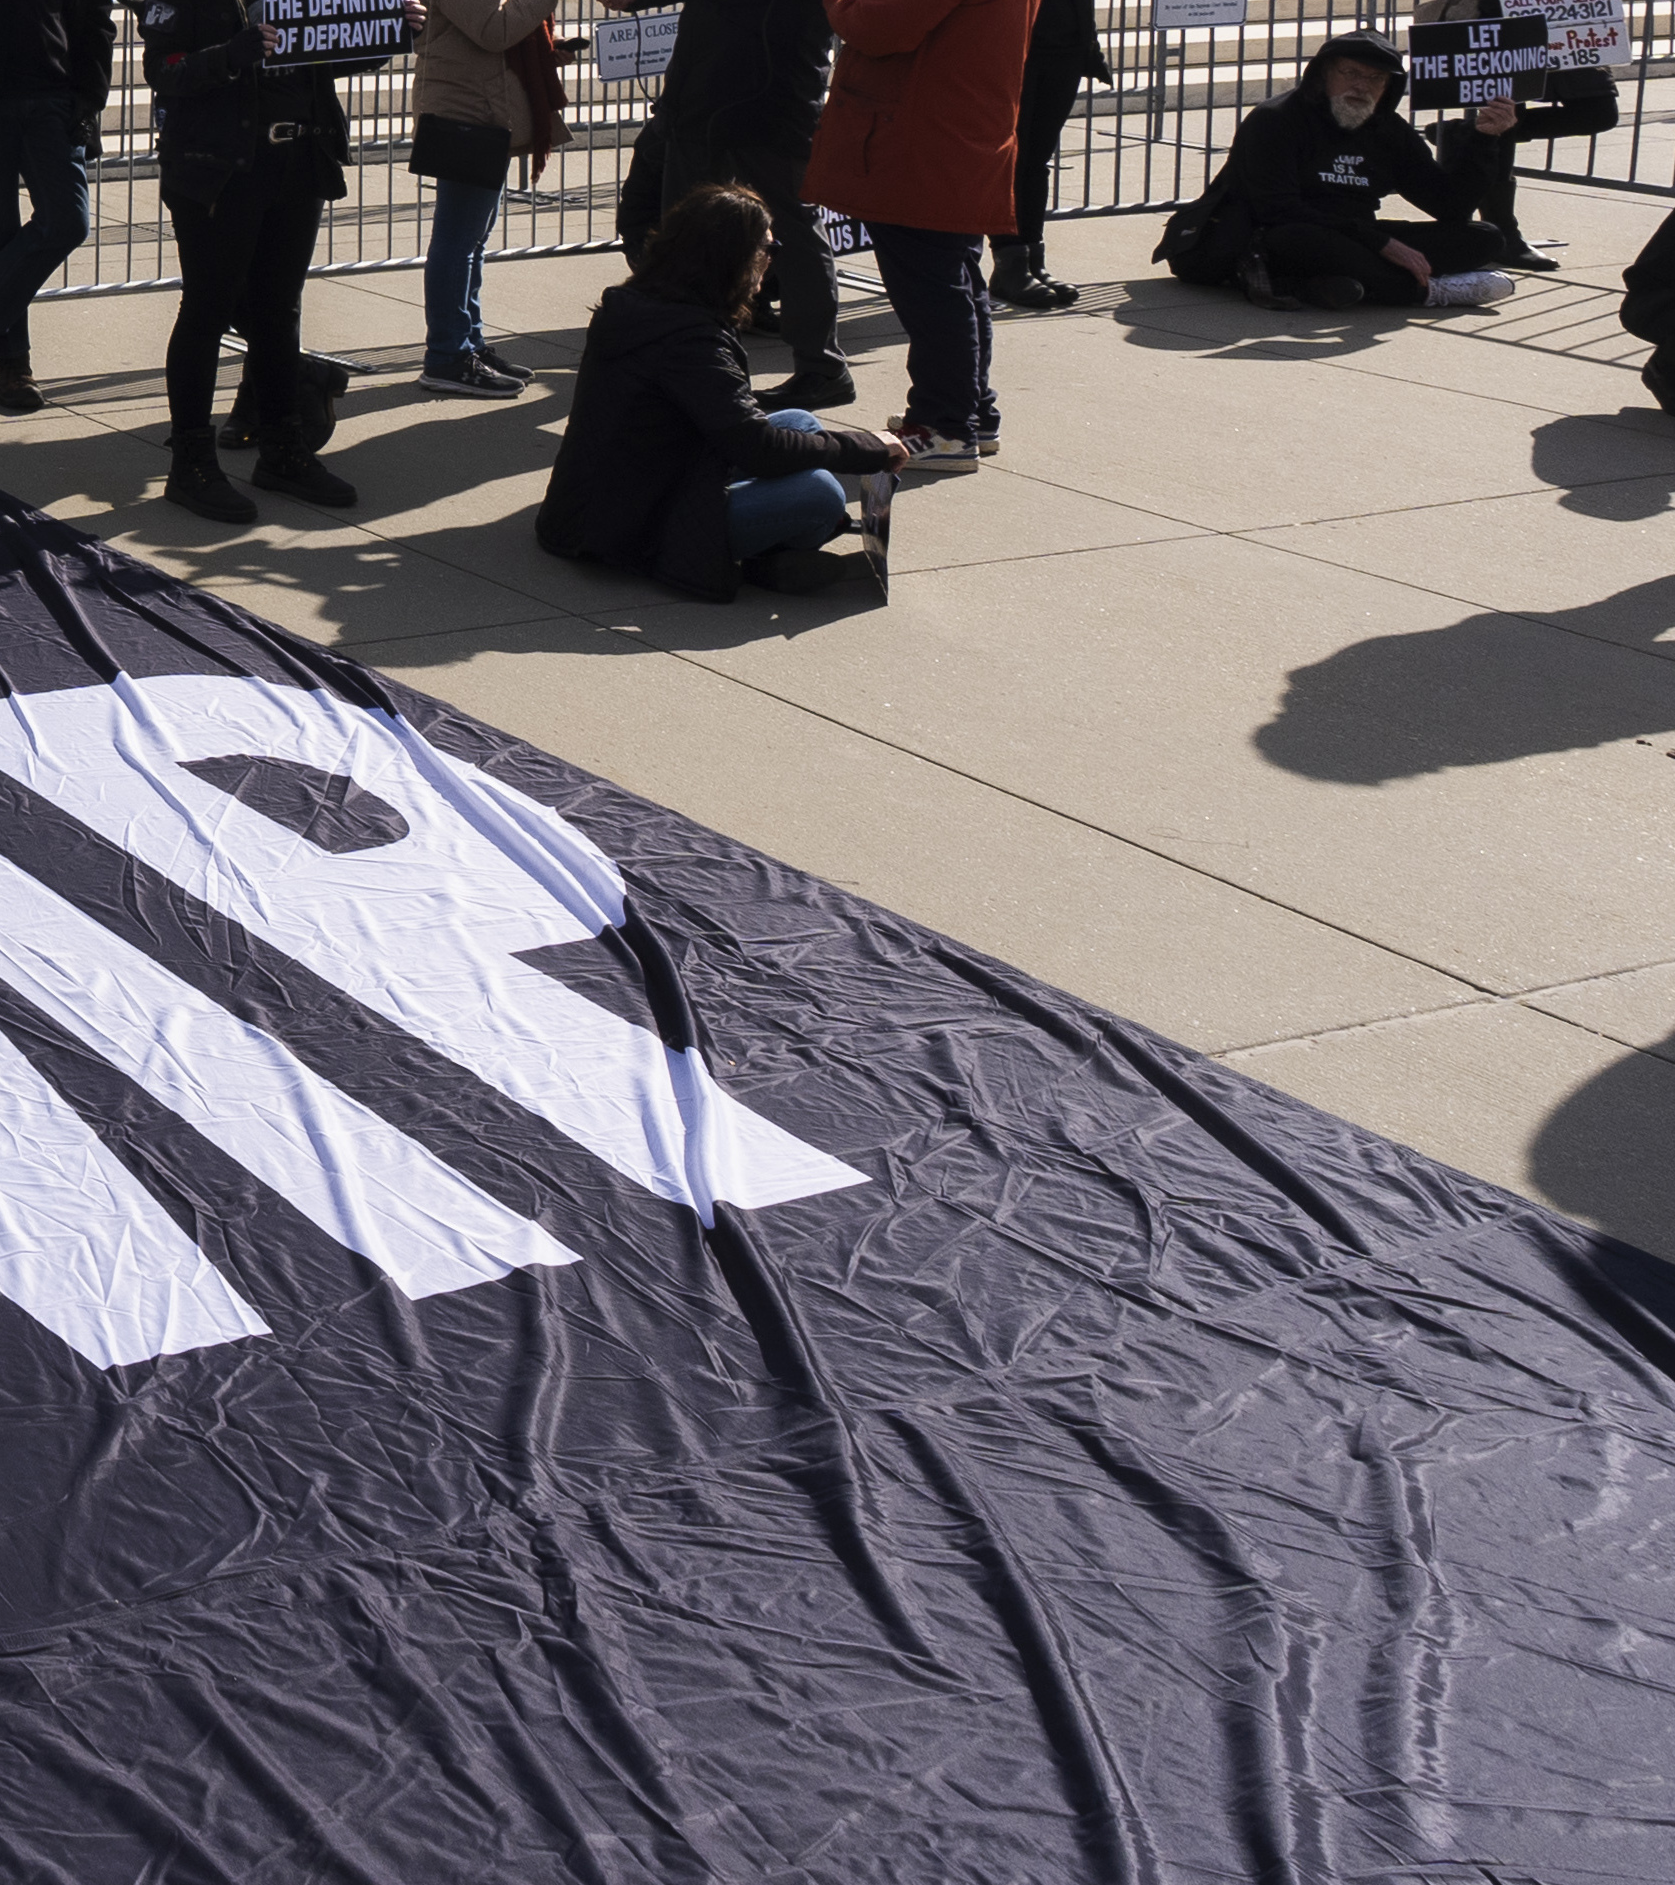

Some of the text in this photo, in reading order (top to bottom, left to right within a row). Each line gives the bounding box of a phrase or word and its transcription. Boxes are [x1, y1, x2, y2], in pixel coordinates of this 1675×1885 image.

[274, 17, 403, 54] OF DEPRAVITY
[645, 22, 679, 37] CLOSE
[1468, 24, 1501, 49] LET
[1566, 27, 1619, 49] Protest
[1412, 45, 1547, 79] THE RECKONING
[1459, 77, 1513, 103] BEGIN
[1334, 155, 1364, 165] UMP
[1318, 172, 1369, 186] TRAITOR
[830, 224, 854, 252] US
